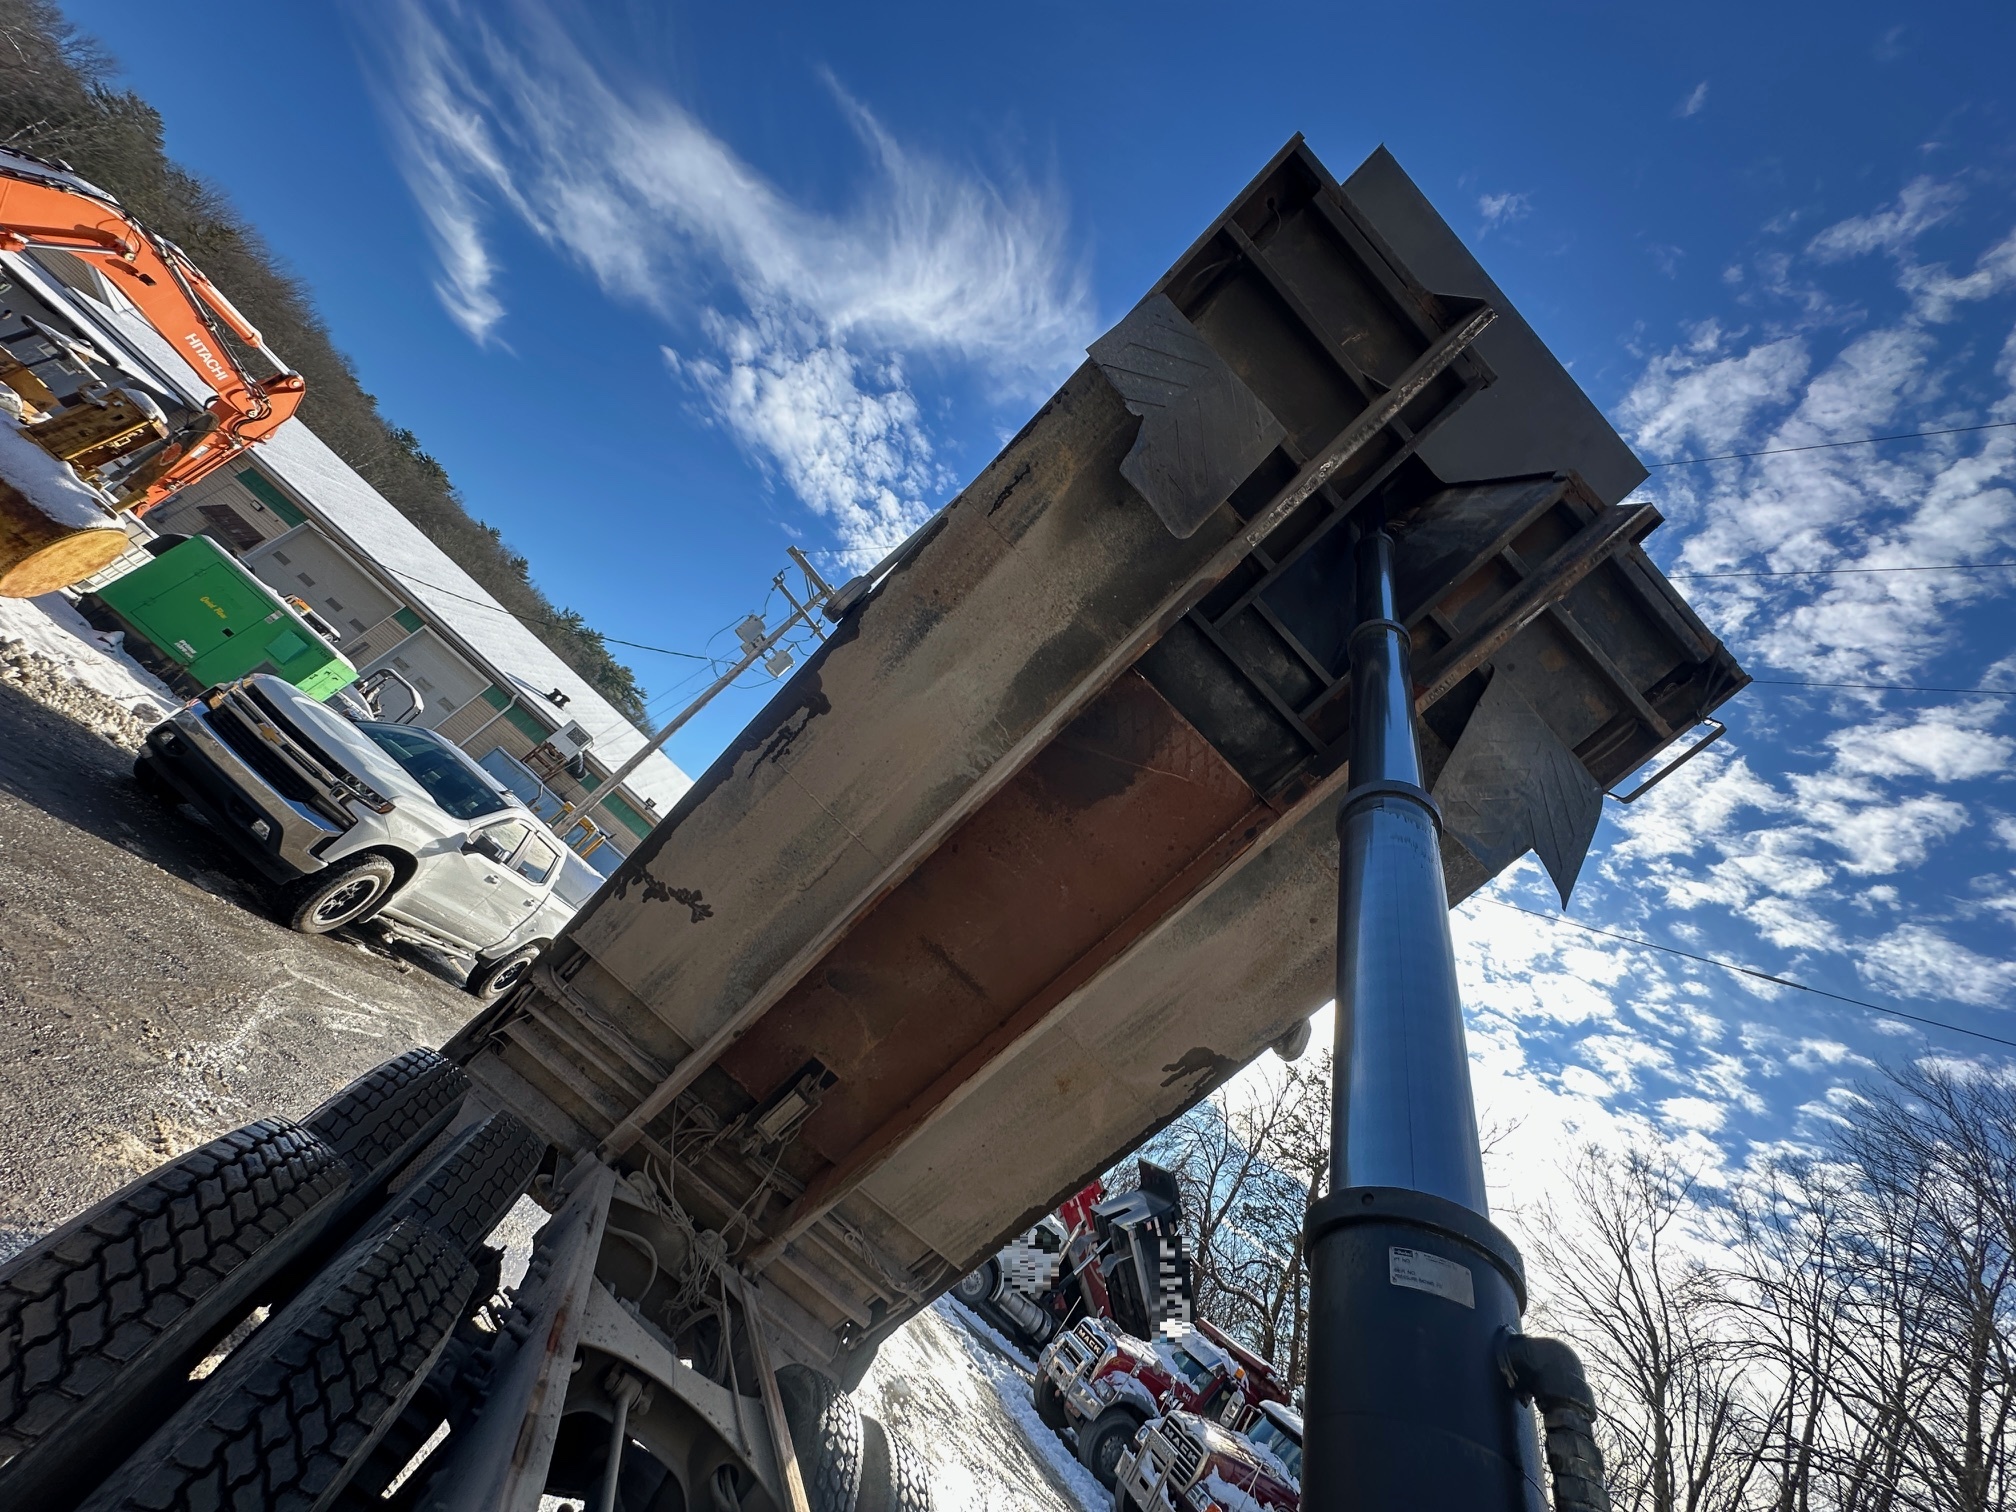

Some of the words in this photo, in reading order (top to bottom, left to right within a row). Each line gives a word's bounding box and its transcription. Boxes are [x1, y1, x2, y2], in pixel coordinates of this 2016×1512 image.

[184, 332, 229, 381] HITACHI
[1076, 1328, 1102, 1356] MACK
[1164, 1426, 1198, 1463] MACK
